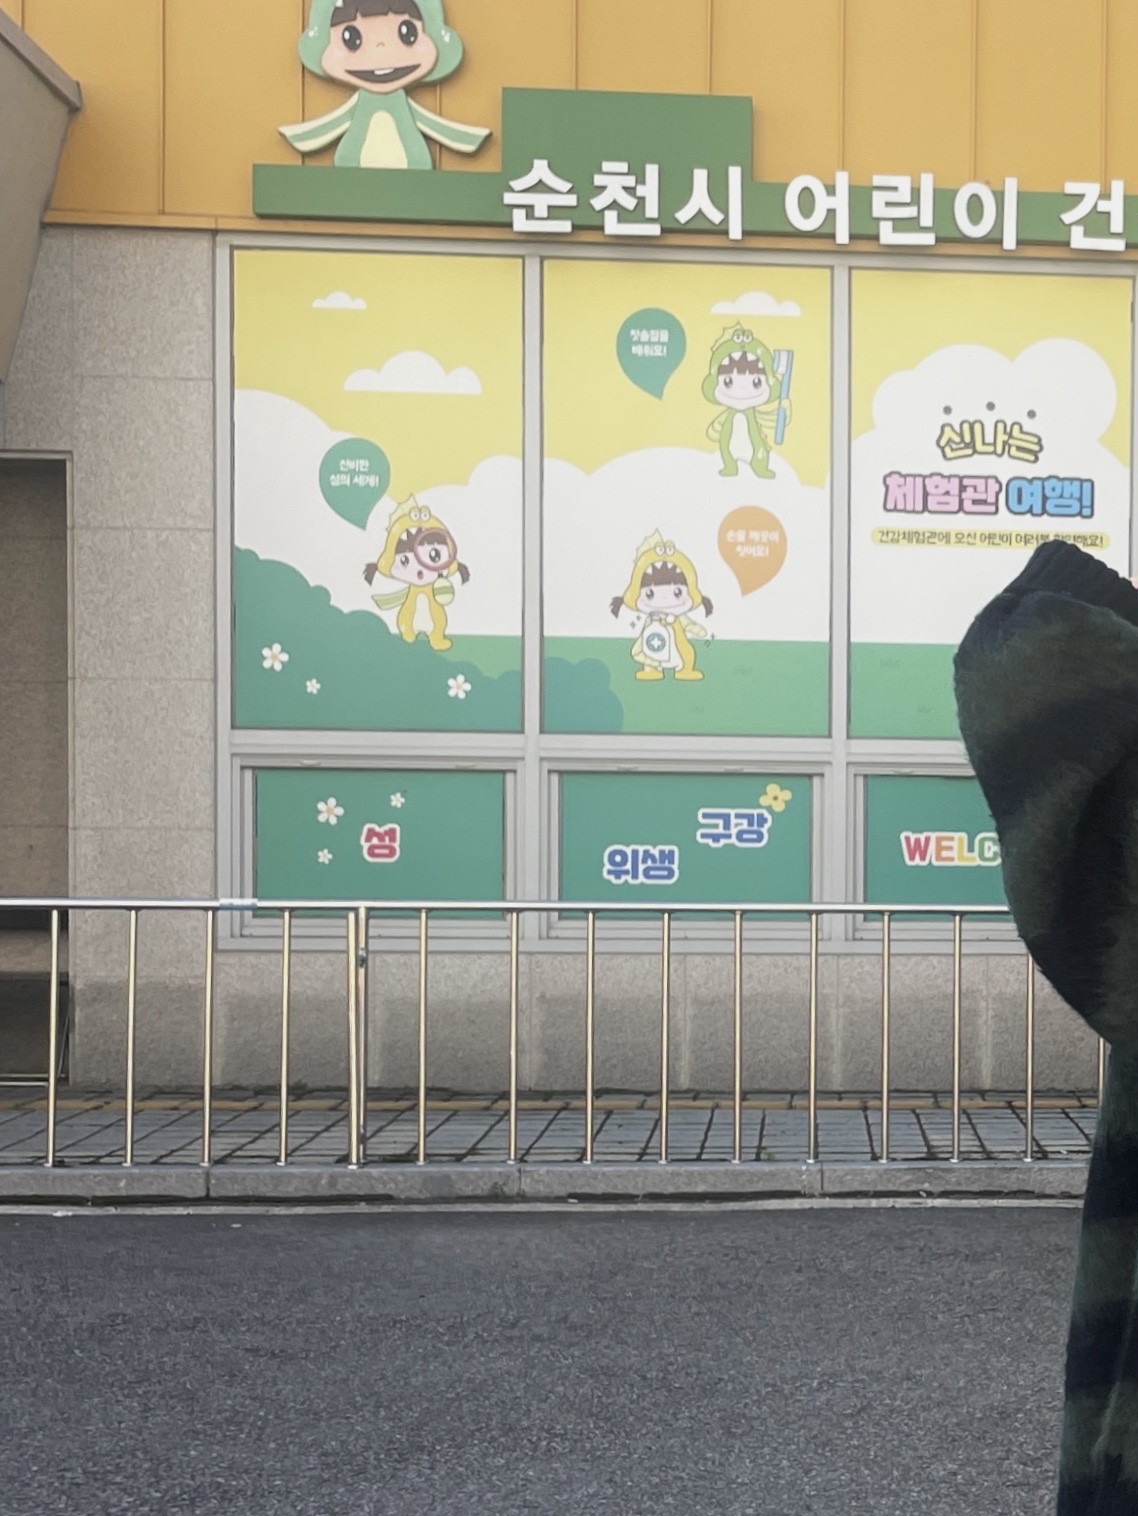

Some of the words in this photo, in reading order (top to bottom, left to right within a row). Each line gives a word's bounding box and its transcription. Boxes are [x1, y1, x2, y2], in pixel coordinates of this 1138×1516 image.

[503, 159, 742, 240] 순천시
[784, 171, 1018, 250] 어린이
[631, 344, 667, 357] 배워요!
[936, 420, 1043, 463] 신나는
[339, 458, 370, 472] 신비한
[883, 471, 1001, 515] 체험관
[1005, 475, 1094, 519] 여행!
[878, 530, 952, 545] 건강체험관에
[954, 531, 977, 546] 오신
[979, 532, 1013, 547] 어린이
[360, 823, 401, 863] 성
[696, 808, 772, 847] 구강
[603, 844, 679, 885] 위생
